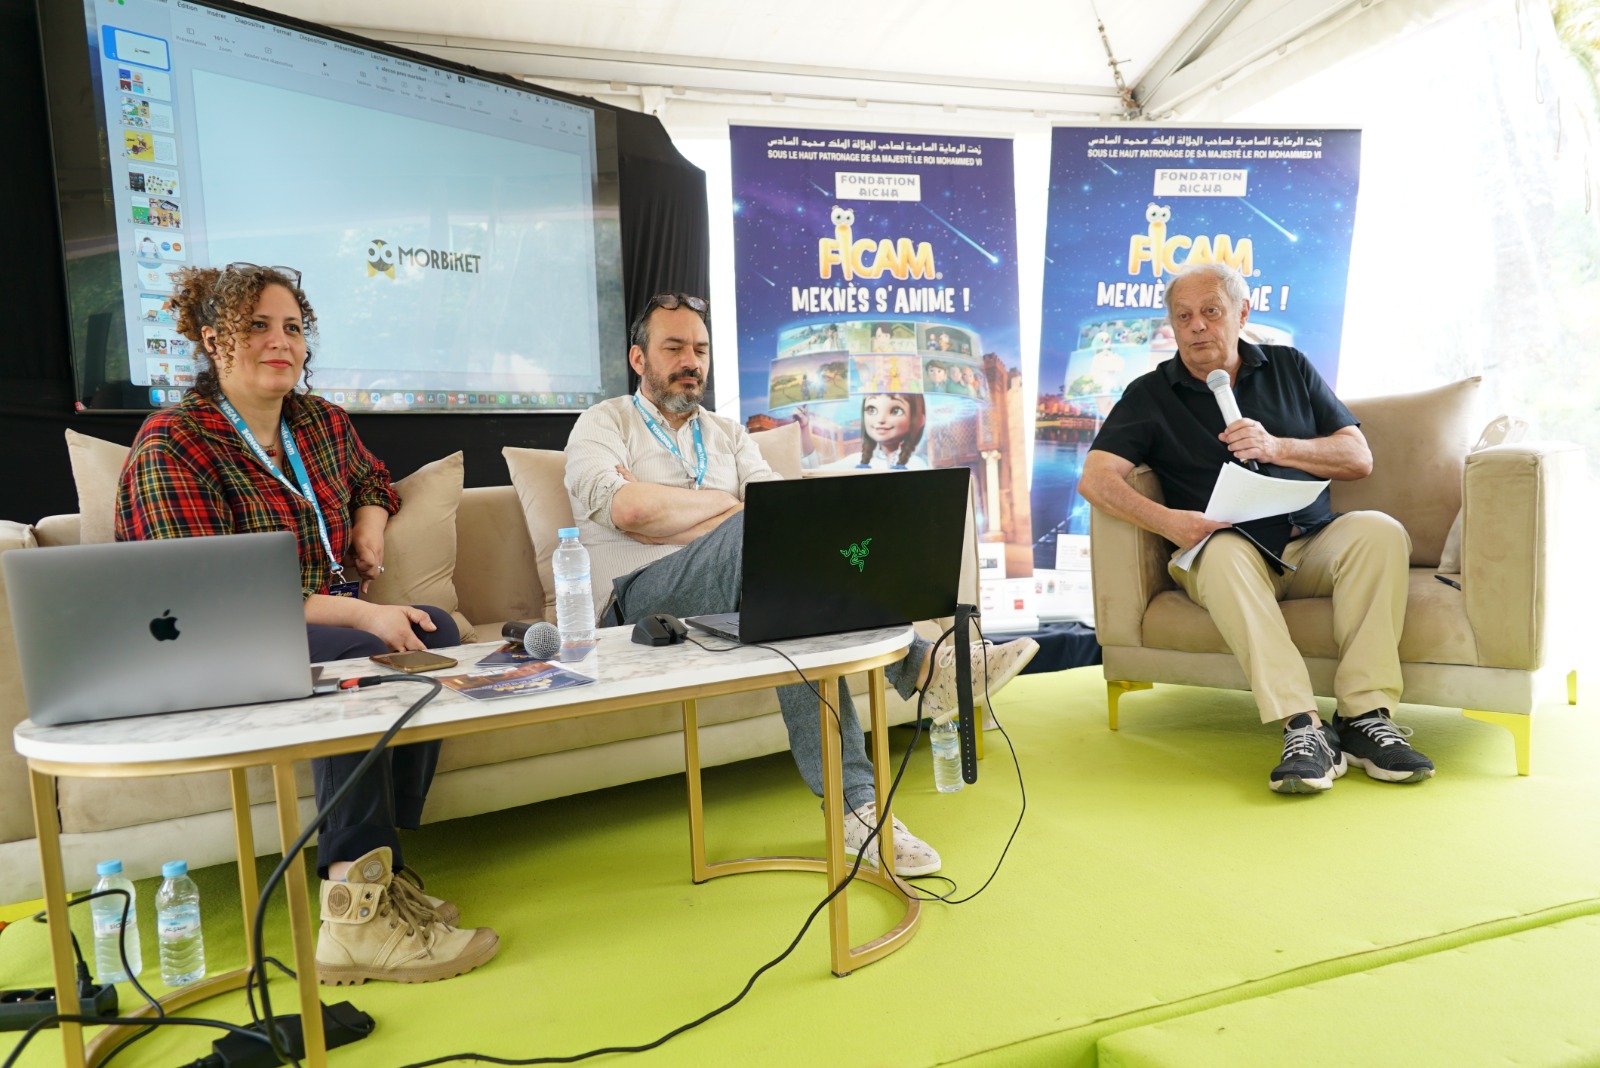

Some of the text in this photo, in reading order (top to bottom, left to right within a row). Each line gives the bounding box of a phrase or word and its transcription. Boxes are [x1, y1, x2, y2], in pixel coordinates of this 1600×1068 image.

[767, 136, 982, 155] تحت الرعاية السامية لصاحب الجلالة الملك محمد السادس
[1088, 134, 1322, 148] تحت الرعاية السامية لصاحب الجلالة الملك محمد السادس
[767, 149, 983, 166] SOUS LE HAUT PATRONAGE DE SA MAJESTÉ LE ROI MOHAMMED VI
[1087, 149, 1322, 159] SOUS LE HAUT PATRONAGE DE SA MAJESTÉ LE ROI MOHAMMED VI
[840, 175, 916, 186] FONDATION
[1160, 172, 1243, 181] FONDATION
[858, 187, 899, 198] AICHA
[1178, 184, 1222, 193] AICHA
[791, 282, 970, 314] MEKNÈS S'ANIME !
[1096, 279, 1166, 309] MEKNÈ
[241, 428, 275, 471] TV5MONDE
